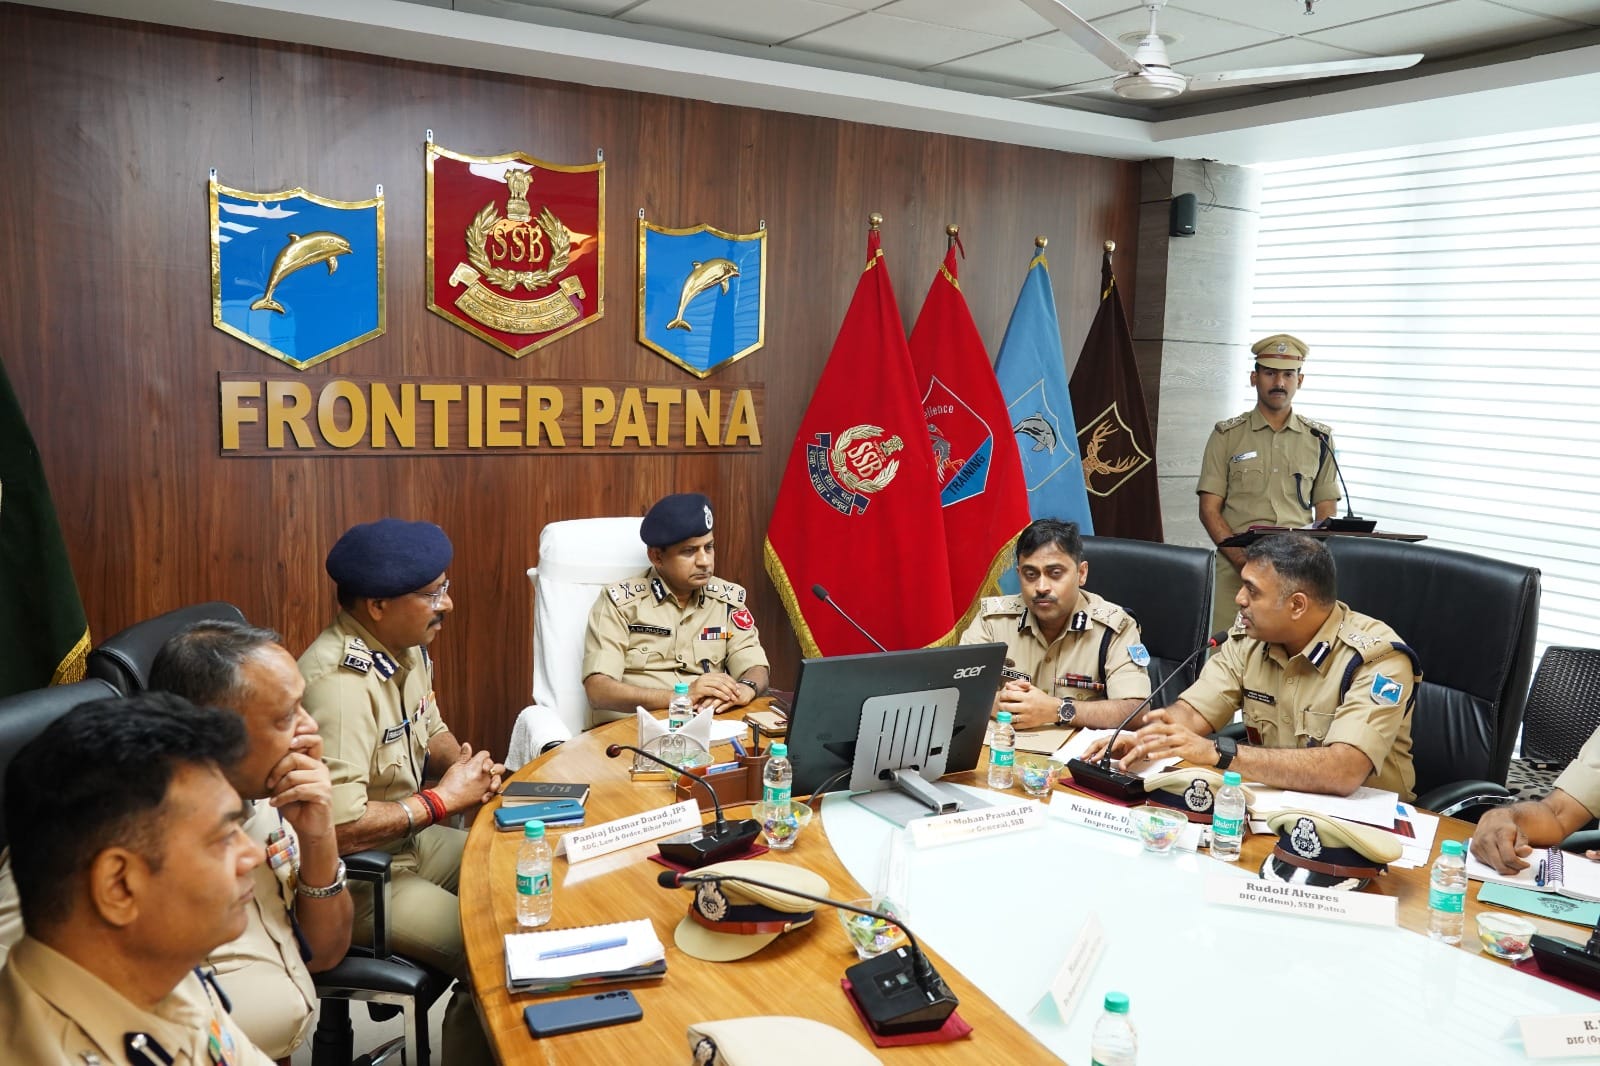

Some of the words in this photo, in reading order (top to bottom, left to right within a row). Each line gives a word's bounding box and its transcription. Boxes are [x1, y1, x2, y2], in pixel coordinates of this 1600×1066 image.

[492, 224, 545, 263] SSB
[220, 380, 566, 449] FRONTIER
[581, 385, 761, 447] PATNA
[846, 441, 883, 478] SSB
[946, 453, 986, 496] TRAINING
[953, 665, 986, 679] acer
[953, 815, 984, 826] Mohan
[1070, 803, 1102, 818] Nishit
[1104, 812, 1119, 822] Kr.
[573, 830, 607, 844] Pankaj
[608, 820, 639, 834] Kumar
[640, 811, 668, 824] Darad
[1083, 817, 1123, 832] Inspector
[1239, 892, 1256, 901] DIG
[1298, 901, 1315, 910] SSB
[1317, 902, 1347, 914] Patna
[1246, 882, 1290, 896] Rudolf
[1291, 888, 1340, 903] Alvares
[1566, 1036, 1585, 1045] DIG
